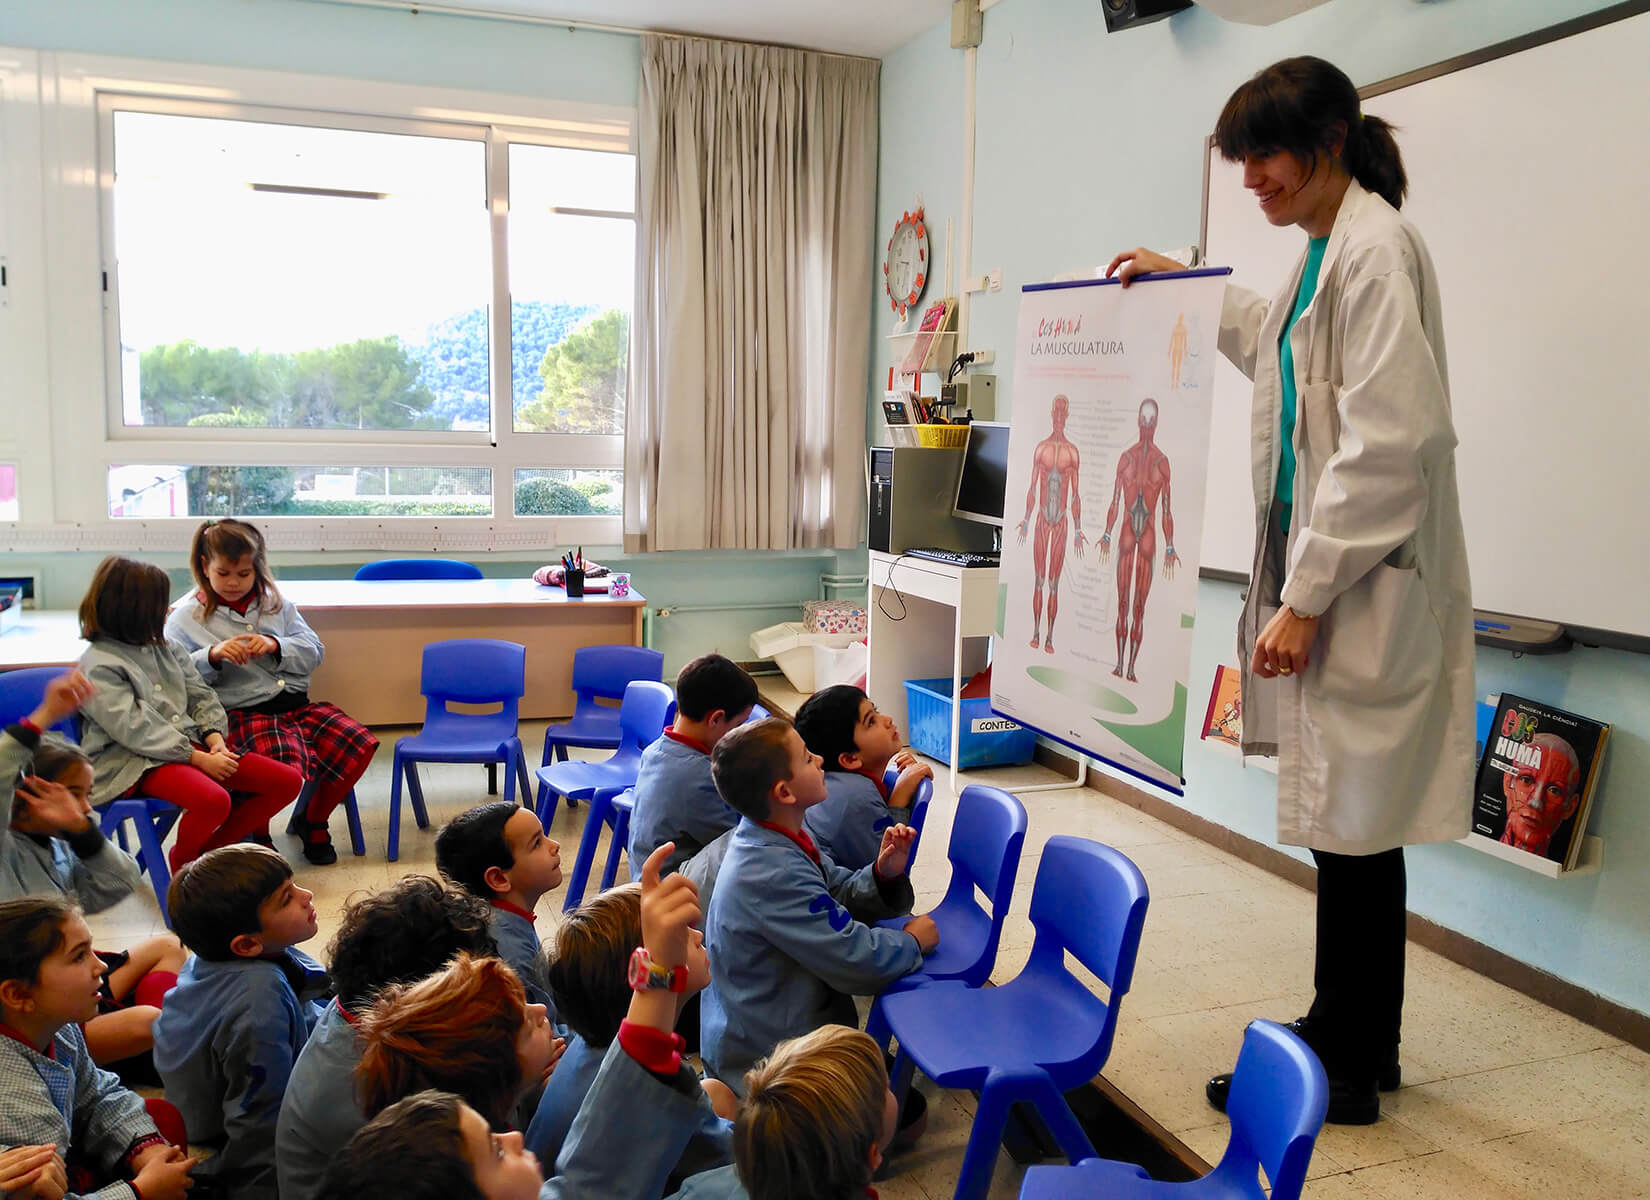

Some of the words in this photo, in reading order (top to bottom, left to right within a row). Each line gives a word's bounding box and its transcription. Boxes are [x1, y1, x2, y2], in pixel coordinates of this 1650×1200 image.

[1031, 343, 1042, 355] LA
[1043, 340, 1125, 356] MUSCULATURA
[979, 720, 1016, 731] CONTES
[1502, 708, 1538, 745] COS
[1495, 736, 1542, 770] HUMÀ
